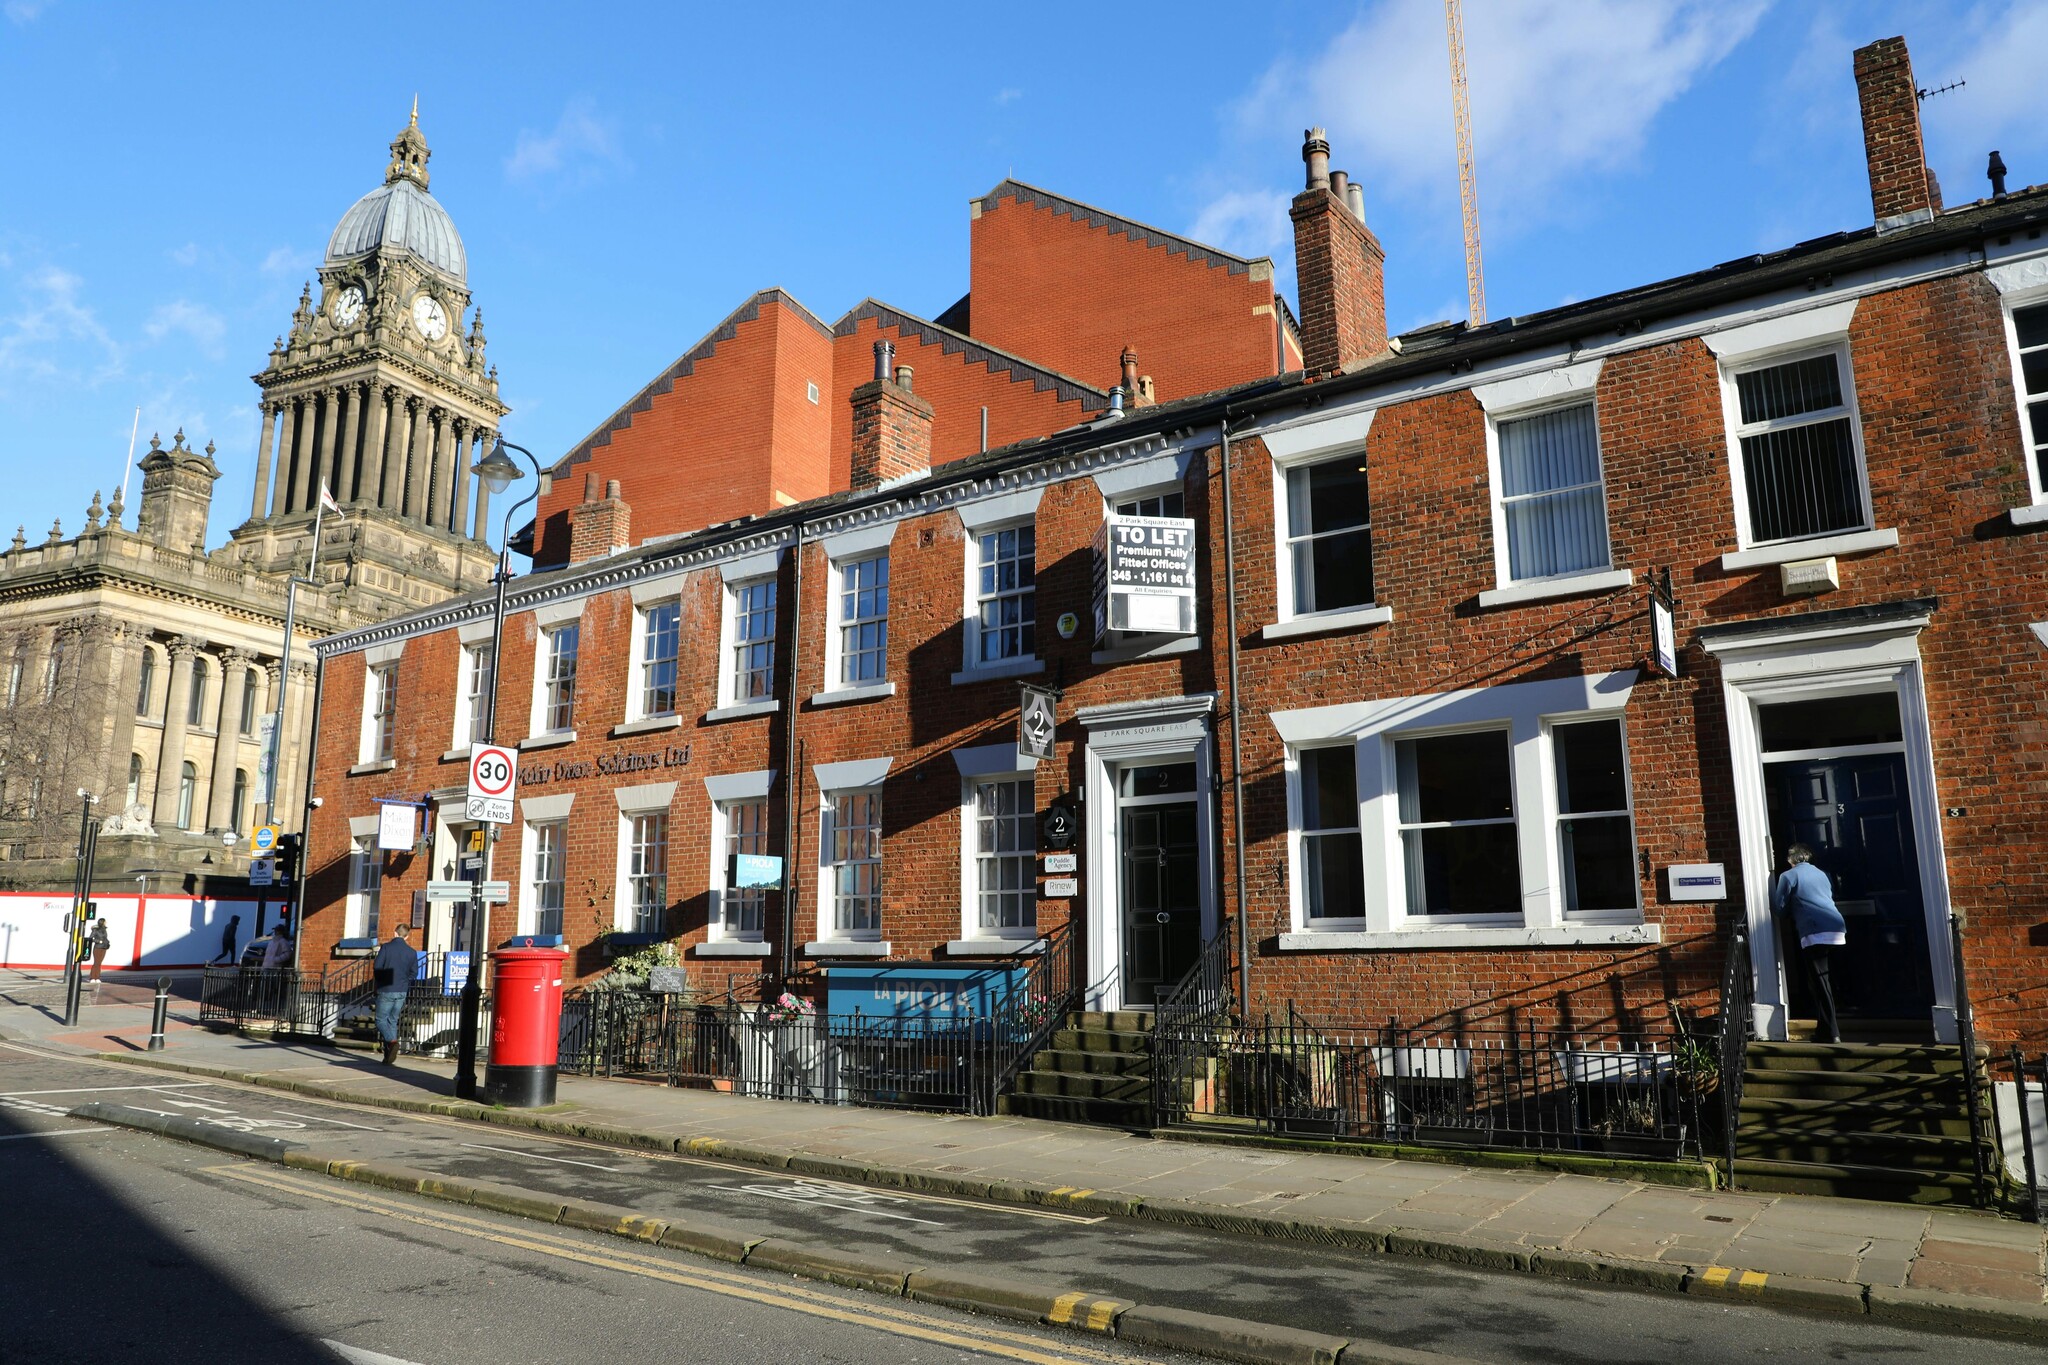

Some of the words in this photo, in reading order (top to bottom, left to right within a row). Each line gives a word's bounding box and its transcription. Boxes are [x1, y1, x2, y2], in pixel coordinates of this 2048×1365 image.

[1143, 518, 1168, 527] Square
[1117, 526, 1145, 544] TO
[1151, 528, 1188, 546] LET
[1117, 545, 1162, 557] Premium
[1165, 547, 1189, 560] Fully
[1119, 557, 1148, 568] Fitted
[1150, 559, 1187, 570] Offices
[1112, 570, 1131, 582] 345
[1140, 571, 1167, 584] 1,161
[1171, 574, 1183, 586] sq
[1144, 587, 1173, 595] Enquiries
[1660, 613, 1667, 648] 3
[1033, 710, 1045, 737] 2
[1111, 729, 1130, 737] PARK
[1134, 725, 1166, 735] SQUARE
[1170, 723, 1189, 731] EAST
[596, 749, 662, 777] Solicitors
[664, 744, 692, 767] Ltd
[479, 761, 508, 781] 30
[1159, 771, 1168, 788] 2
[471, 804, 483, 813] 20
[487, 810, 511, 820] ENDS
[1837, 803, 1845, 814] 3
[1950, 808, 1960, 817] 3
[384, 811, 412, 824] Makin
[1055, 816, 1065, 833] 2
[473, 833, 483, 849] H
[752, 857, 774, 868] PIOLA
[1049, 881, 1072, 890] Rinew
[874, 981, 890, 1000] LA
[895, 980, 971, 1012] PIOLA
